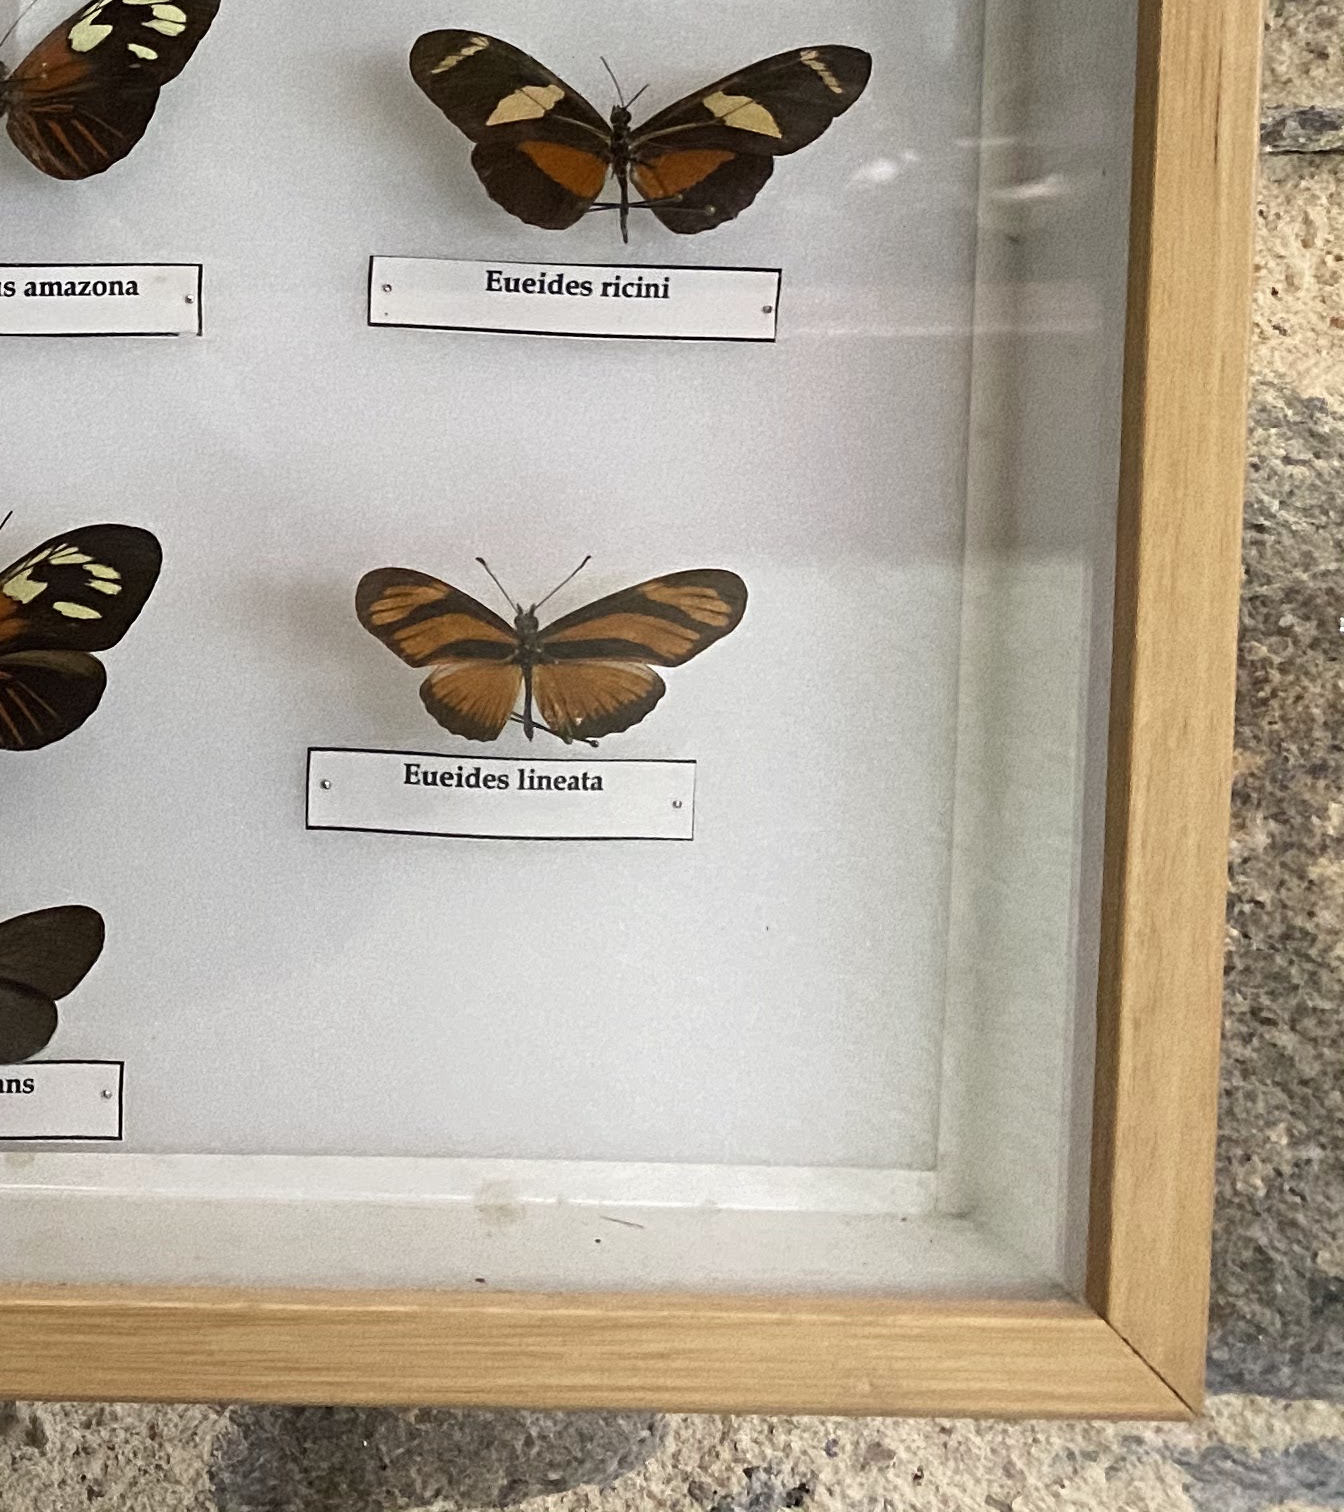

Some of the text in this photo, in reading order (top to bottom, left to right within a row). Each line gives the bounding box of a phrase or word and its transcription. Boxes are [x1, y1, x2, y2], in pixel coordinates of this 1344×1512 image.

[23, 278, 141, 298] amazona
[485, 269, 671, 299] Eueides ricini
[403, 762, 604, 792] Eueides lineata
